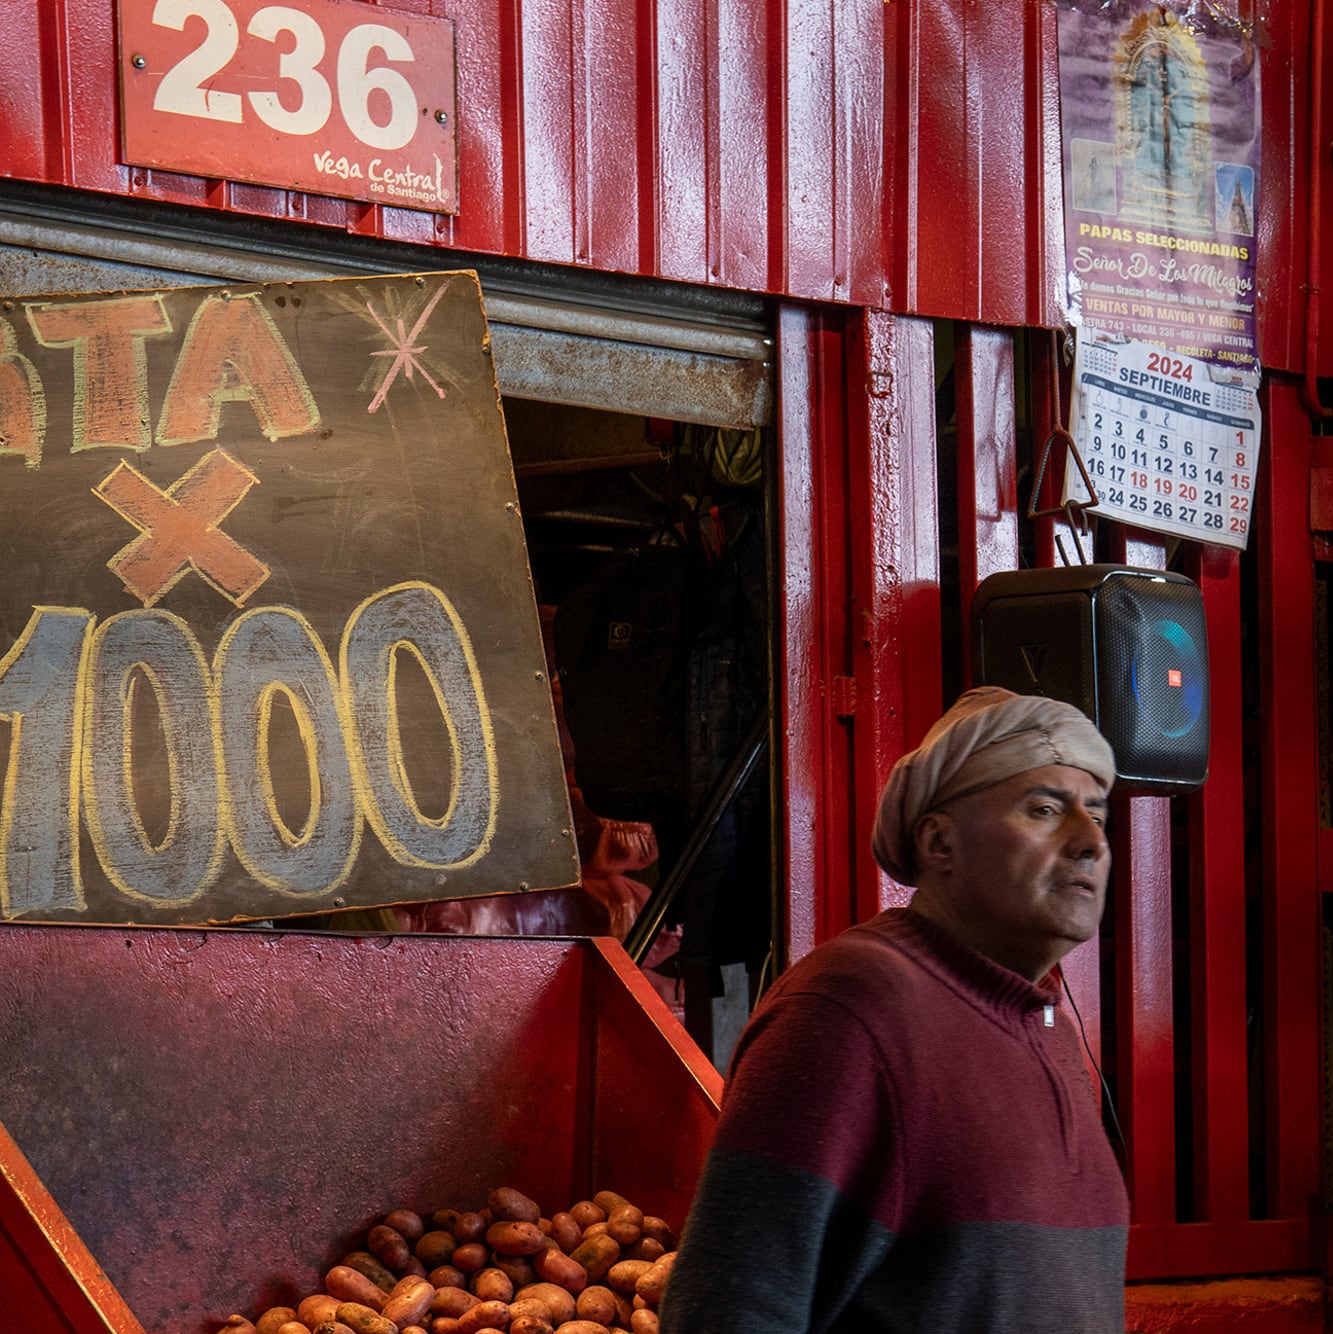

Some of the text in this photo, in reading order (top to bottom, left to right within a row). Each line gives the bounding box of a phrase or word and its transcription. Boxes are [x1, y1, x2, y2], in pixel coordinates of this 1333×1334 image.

[152, 0, 419, 150] 236
[313, 150, 447, 203] Vega Central
[370, 182, 437, 203] de Santiago
[1080, 223, 1249, 260] PAPAS SELECCIONADAS
[1073, 247, 1252, 297] Señor De Los Milagros
[1086, 297, 1246, 331] VENTAS POR MAYOR Y MENOR
[1132, 322, 1157, 336] LOCAL
[1202, 332, 1222, 344] VEGA
[1224, 335, 1254, 349] CENTRAL
[1119, 367, 1212, 407] SEPTIEMBRE
[1147, 352, 1193, 382] 2024
[1094, 413, 1102, 428] 2
[1115, 421, 1123, 436] 3
[1136, 429, 1144, 443] 4
[1160, 435, 1168, 449] 5
[1184, 441, 1193, 455] 6
[1209, 447, 1218, 462] 7
[1236, 453, 1245, 466] 8
[1236, 431, 1244, 445] 1
[1088, 458, 1248, 512] 16 17 18 19 20 21 22
[1094, 436, 1250, 489] 9 10 11 12 13 14 15
[1109, 488, 1124, 505] 24
[1129, 495, 1147, 511] 25
[1154, 501, 1172, 516] 26
[1179, 506, 1197, 523] 27
[1204, 513, 1223, 528] 28
[1230, 517, 1247, 533] 29
[0, 580, 498, 918] 1000
